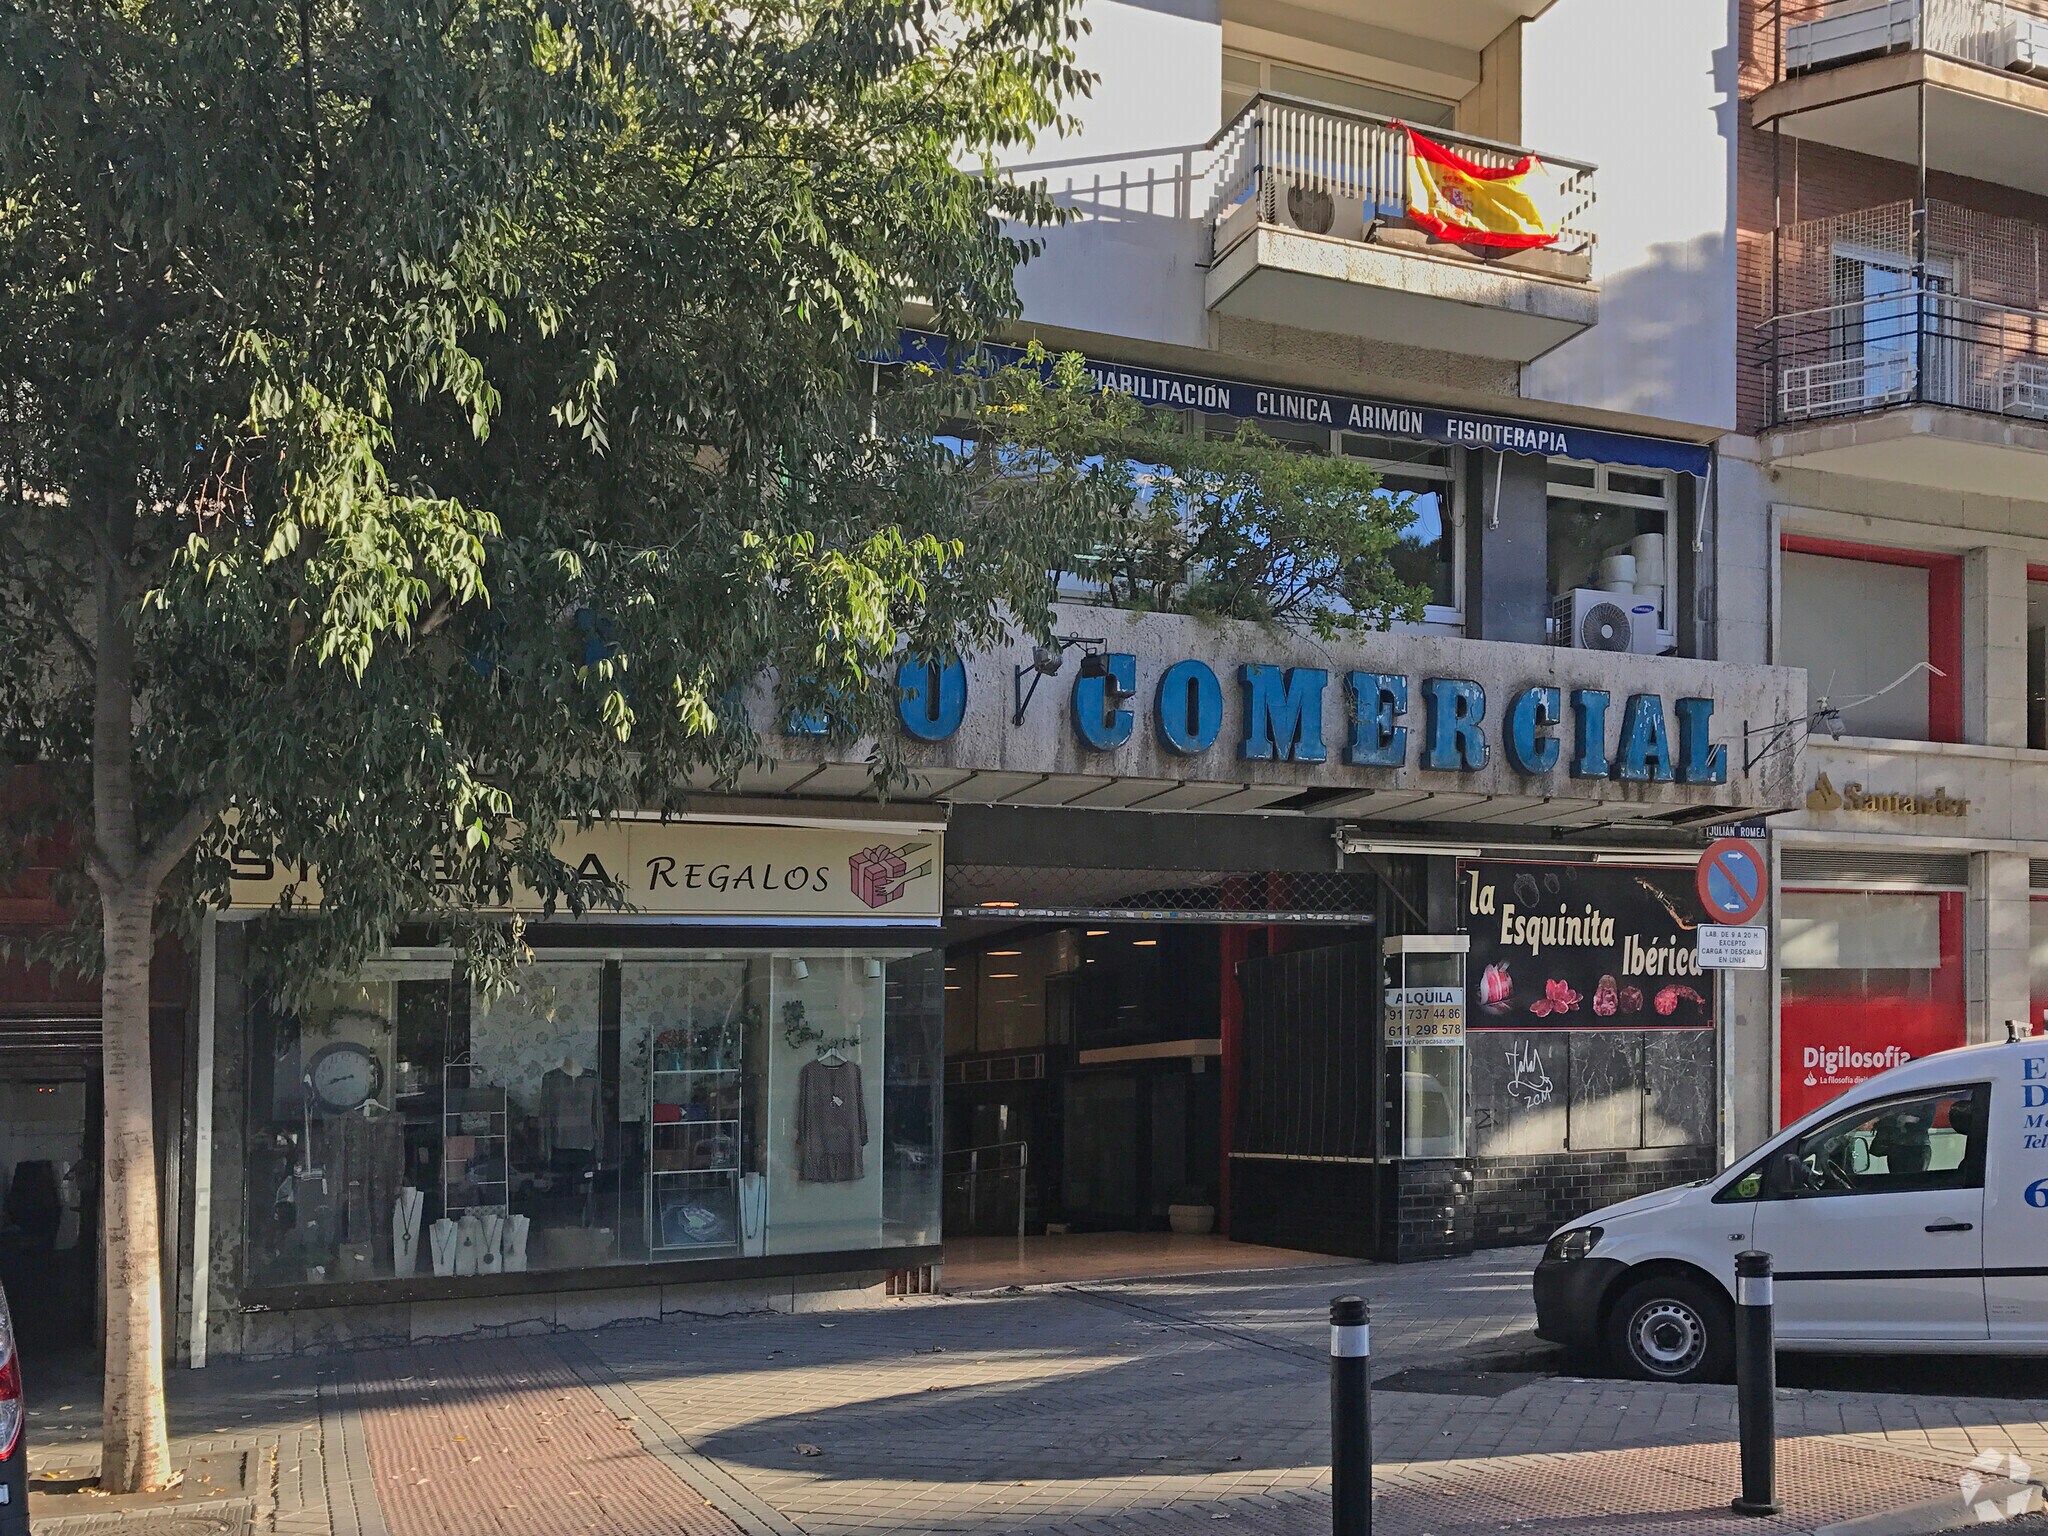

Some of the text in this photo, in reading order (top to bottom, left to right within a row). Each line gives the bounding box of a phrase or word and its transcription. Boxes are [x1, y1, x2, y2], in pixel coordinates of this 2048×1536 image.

[1256, 391, 1333, 424] CLINICA
[1348, 403, 1423, 434] ARIMÓN
[1446, 418, 1568, 453] FISIOTERAPIA
[1071, 652, 1728, 786] COMERCIAL
[1844, 782, 1971, 817] Santander
[1708, 825, 1766, 838] JULIÁN ROMEA
[1466, 870, 1496, 916] la
[1500, 903, 1616, 956] Esquinita
[1622, 934, 1704, 977] Ibérica
[1395, 992, 1454, 1006] ALQUILA
[1389, 1008, 1461, 1021] 91 737 44 86
[1388, 1024, 1461, 1037] 611 298 578
[1820, 1076, 1828, 1084] La
[1828, 1075, 1854, 1084] filosofía
[2023, 1114, 2048, 1129] M
